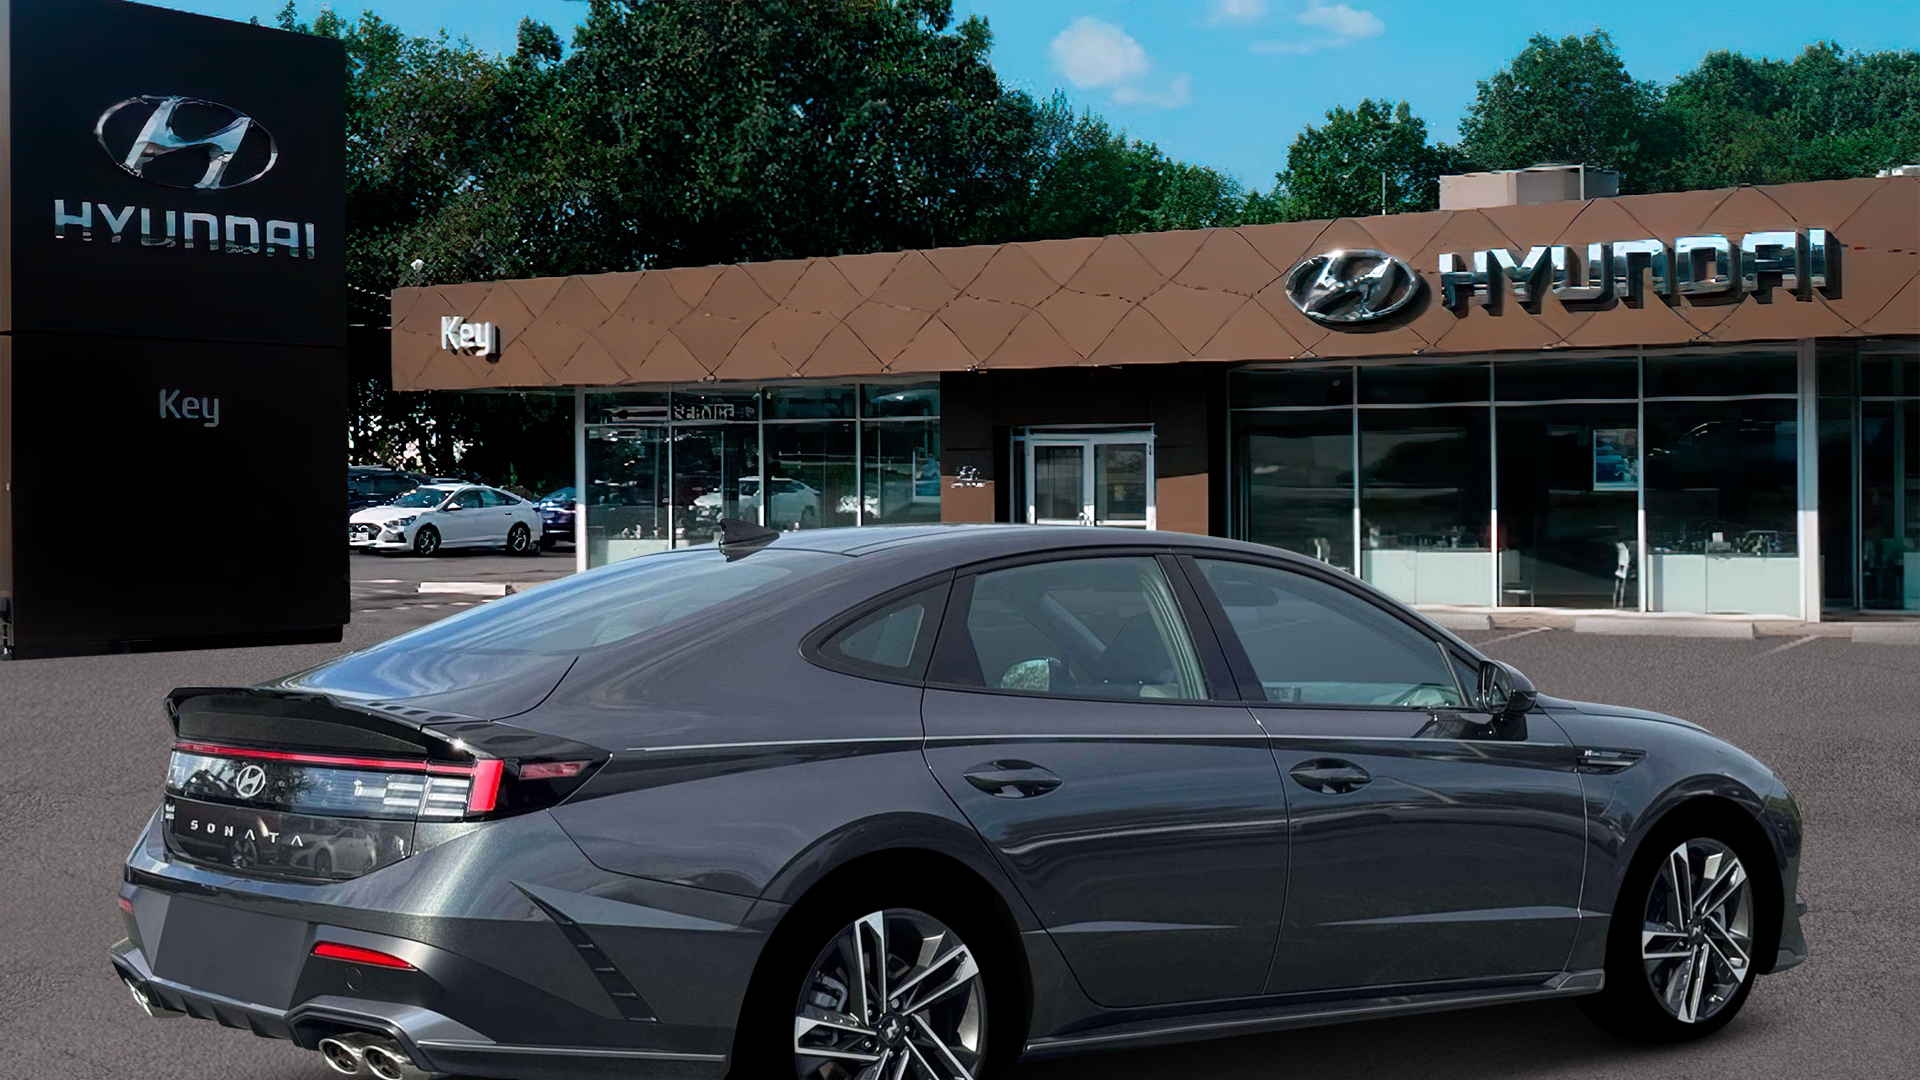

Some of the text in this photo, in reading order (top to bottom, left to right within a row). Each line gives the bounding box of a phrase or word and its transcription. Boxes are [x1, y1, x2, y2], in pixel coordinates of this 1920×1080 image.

[54, 199, 316, 259] HYUNDAI
[1439, 228, 1839, 315] HYUNDAI
[440, 315, 502, 357] Key
[158, 388, 220, 428] Key
[190, 819, 304, 847] SONATA
